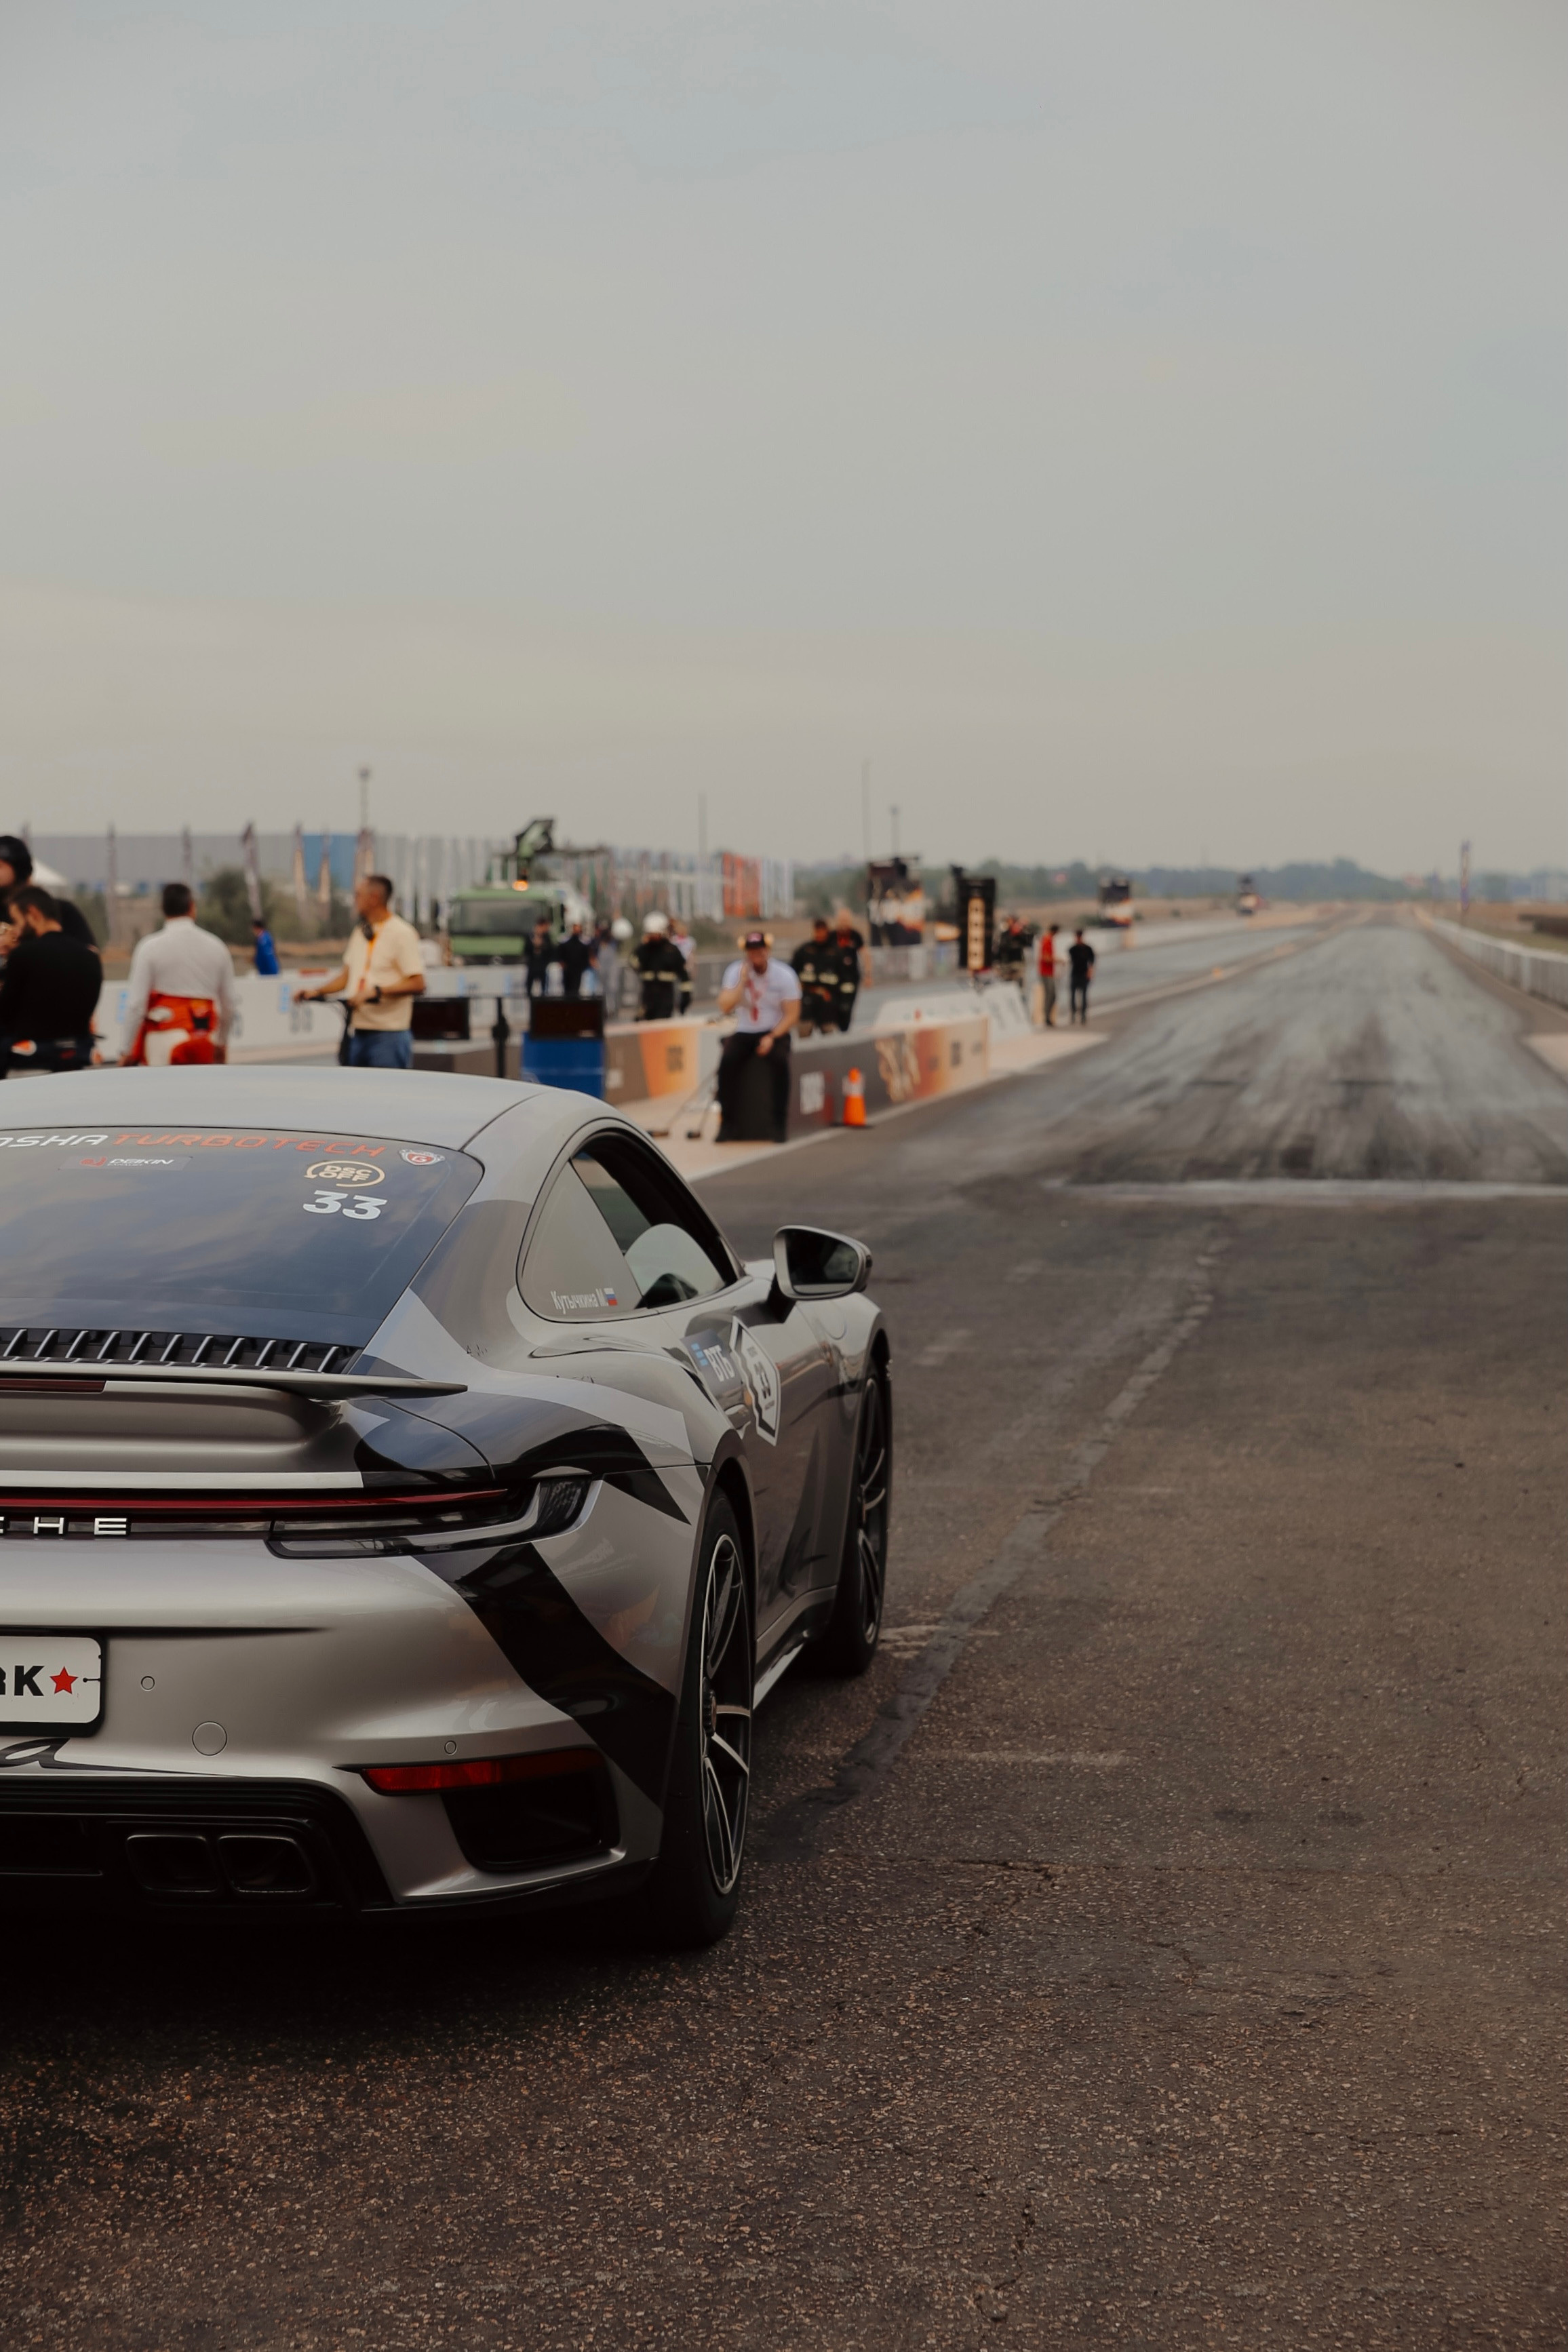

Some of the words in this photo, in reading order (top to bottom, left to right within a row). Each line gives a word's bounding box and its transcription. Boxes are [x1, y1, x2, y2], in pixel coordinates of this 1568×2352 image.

[112, 1133, 387, 1158] TURBOTECH
[318, 1171, 370, 1182] OFF
[324, 1164, 373, 1176] DSC
[302, 1190, 388, 1220] 33
[0, 1516, 128, 1535] HE
